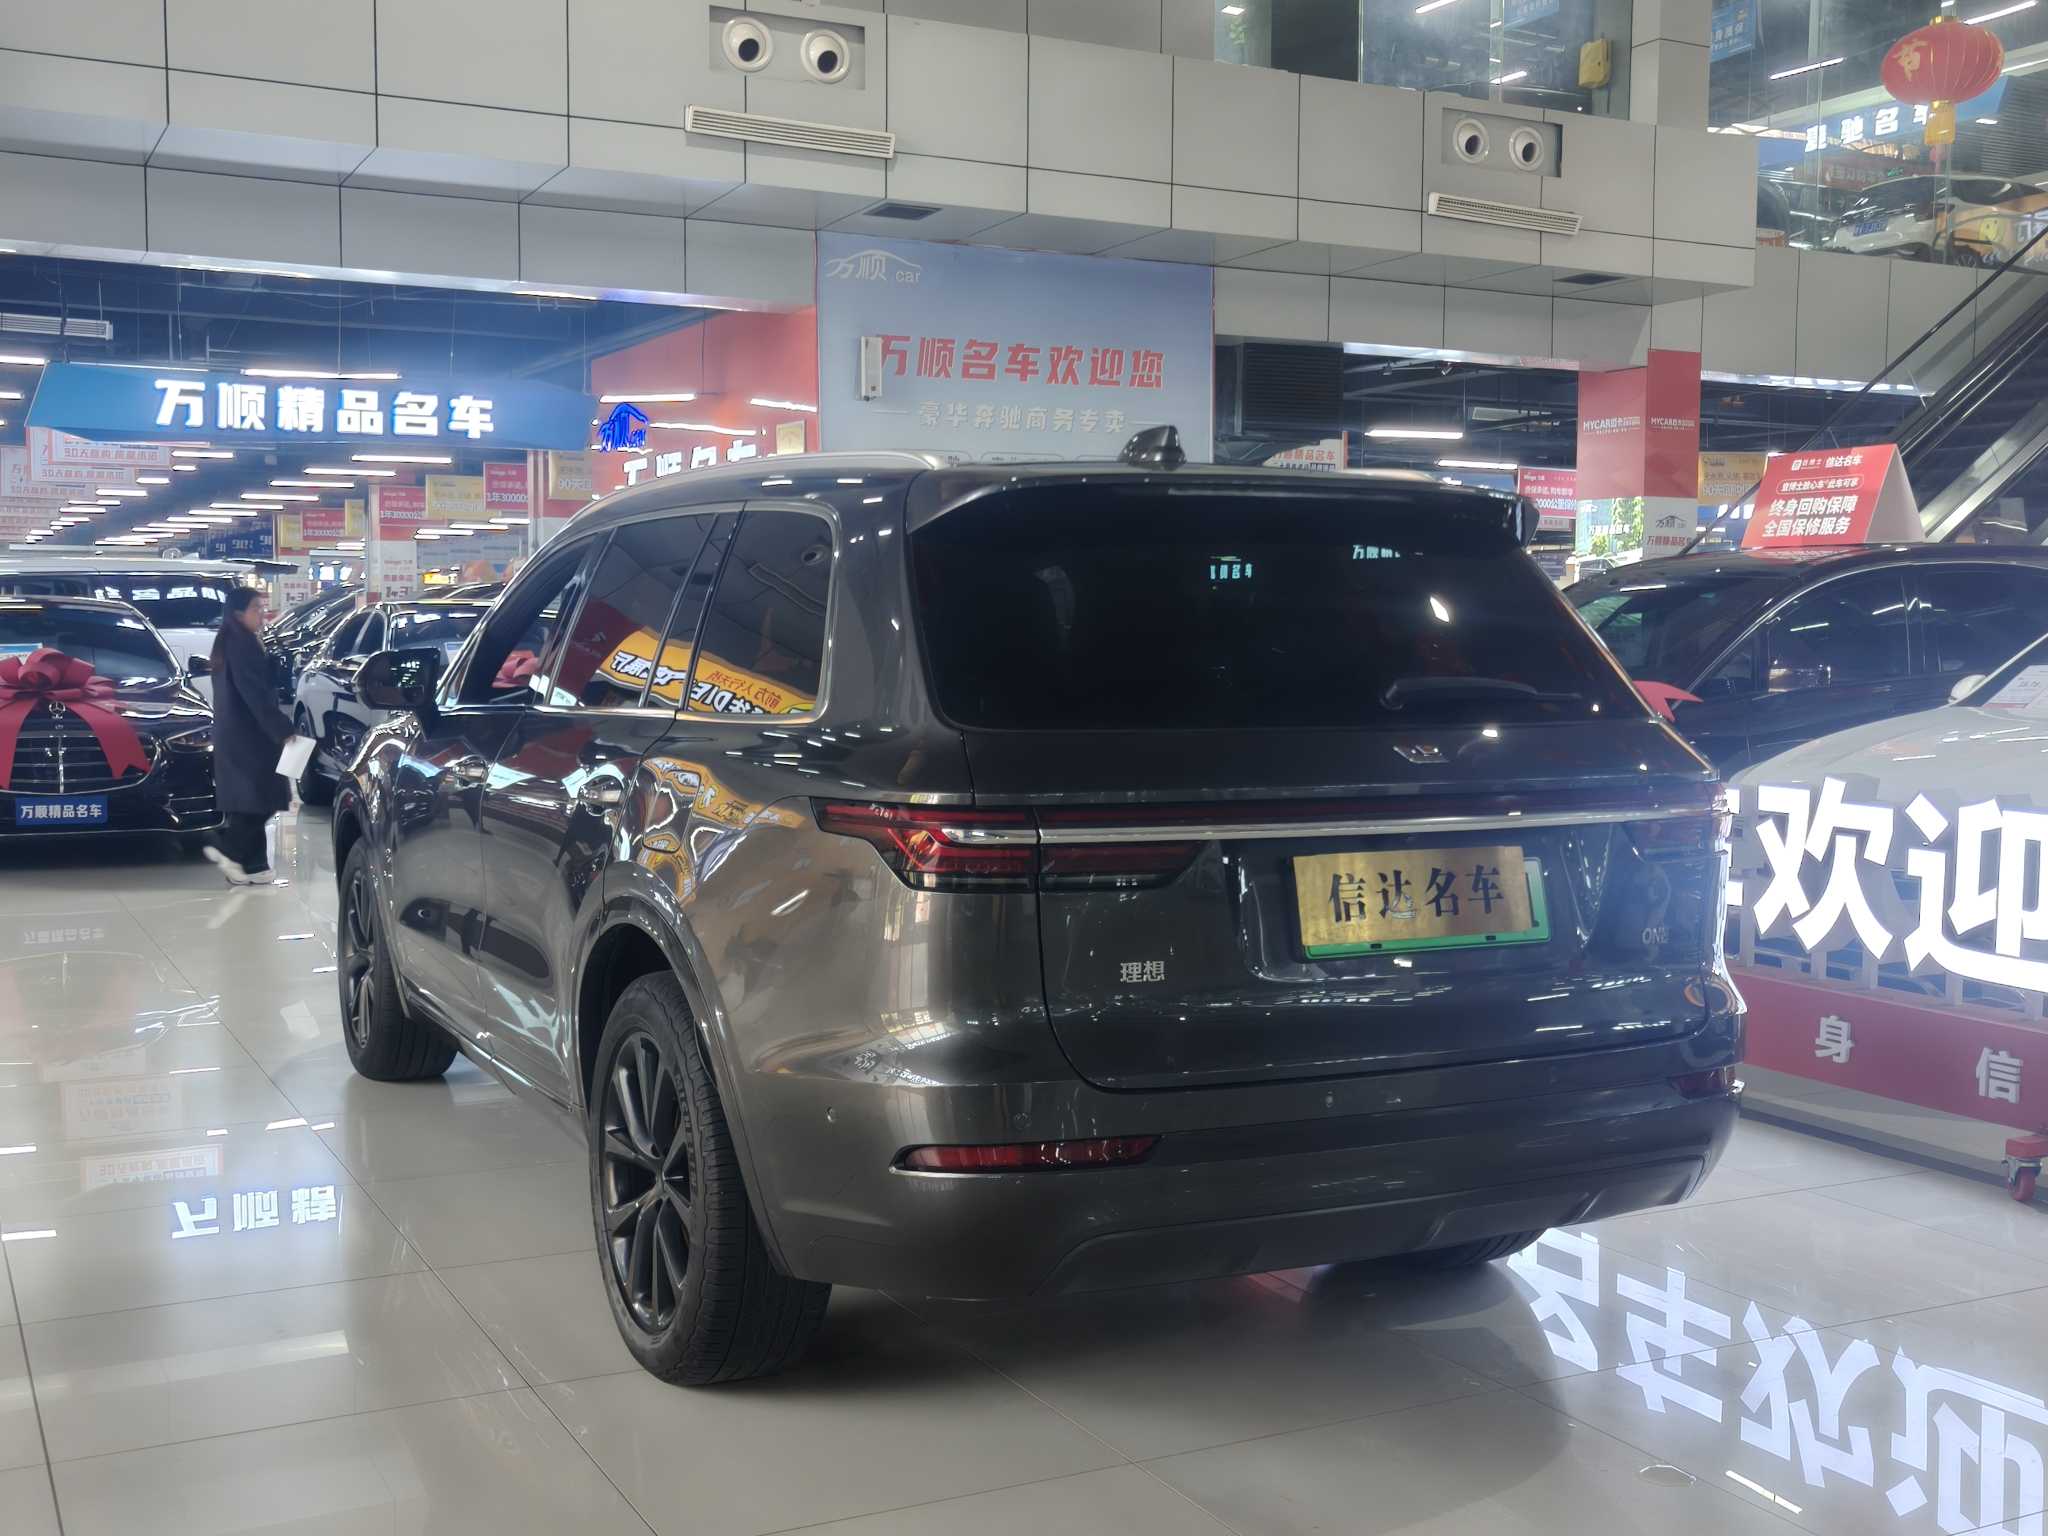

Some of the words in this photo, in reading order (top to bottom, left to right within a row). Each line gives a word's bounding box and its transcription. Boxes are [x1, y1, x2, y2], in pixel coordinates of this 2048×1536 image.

[826, 254, 887, 281] 万顺
[895, 270, 921, 283] car
[878, 334, 1165, 389] 万顺名车欢迎您
[155, 378, 494, 438] 万顺精品名车
[919, 401, 1127, 433] 豪华奔驰商务专卖
[1825, 454, 1864, 469] 信达名车
[1768, 495, 1859, 517] 终身回购保障
[1762, 517, 1852, 538] 全国保修服务
[20, 804, 103, 820] 万顺精品名车
[1329, 864, 1504, 923] 信达名车
[1725, 776, 2048, 994] 欢迎
[1120, 960, 1165, 983] 理想
[1815, 1015, 1854, 1064] 身
[1976, 1046, 2024, 1104] 信
